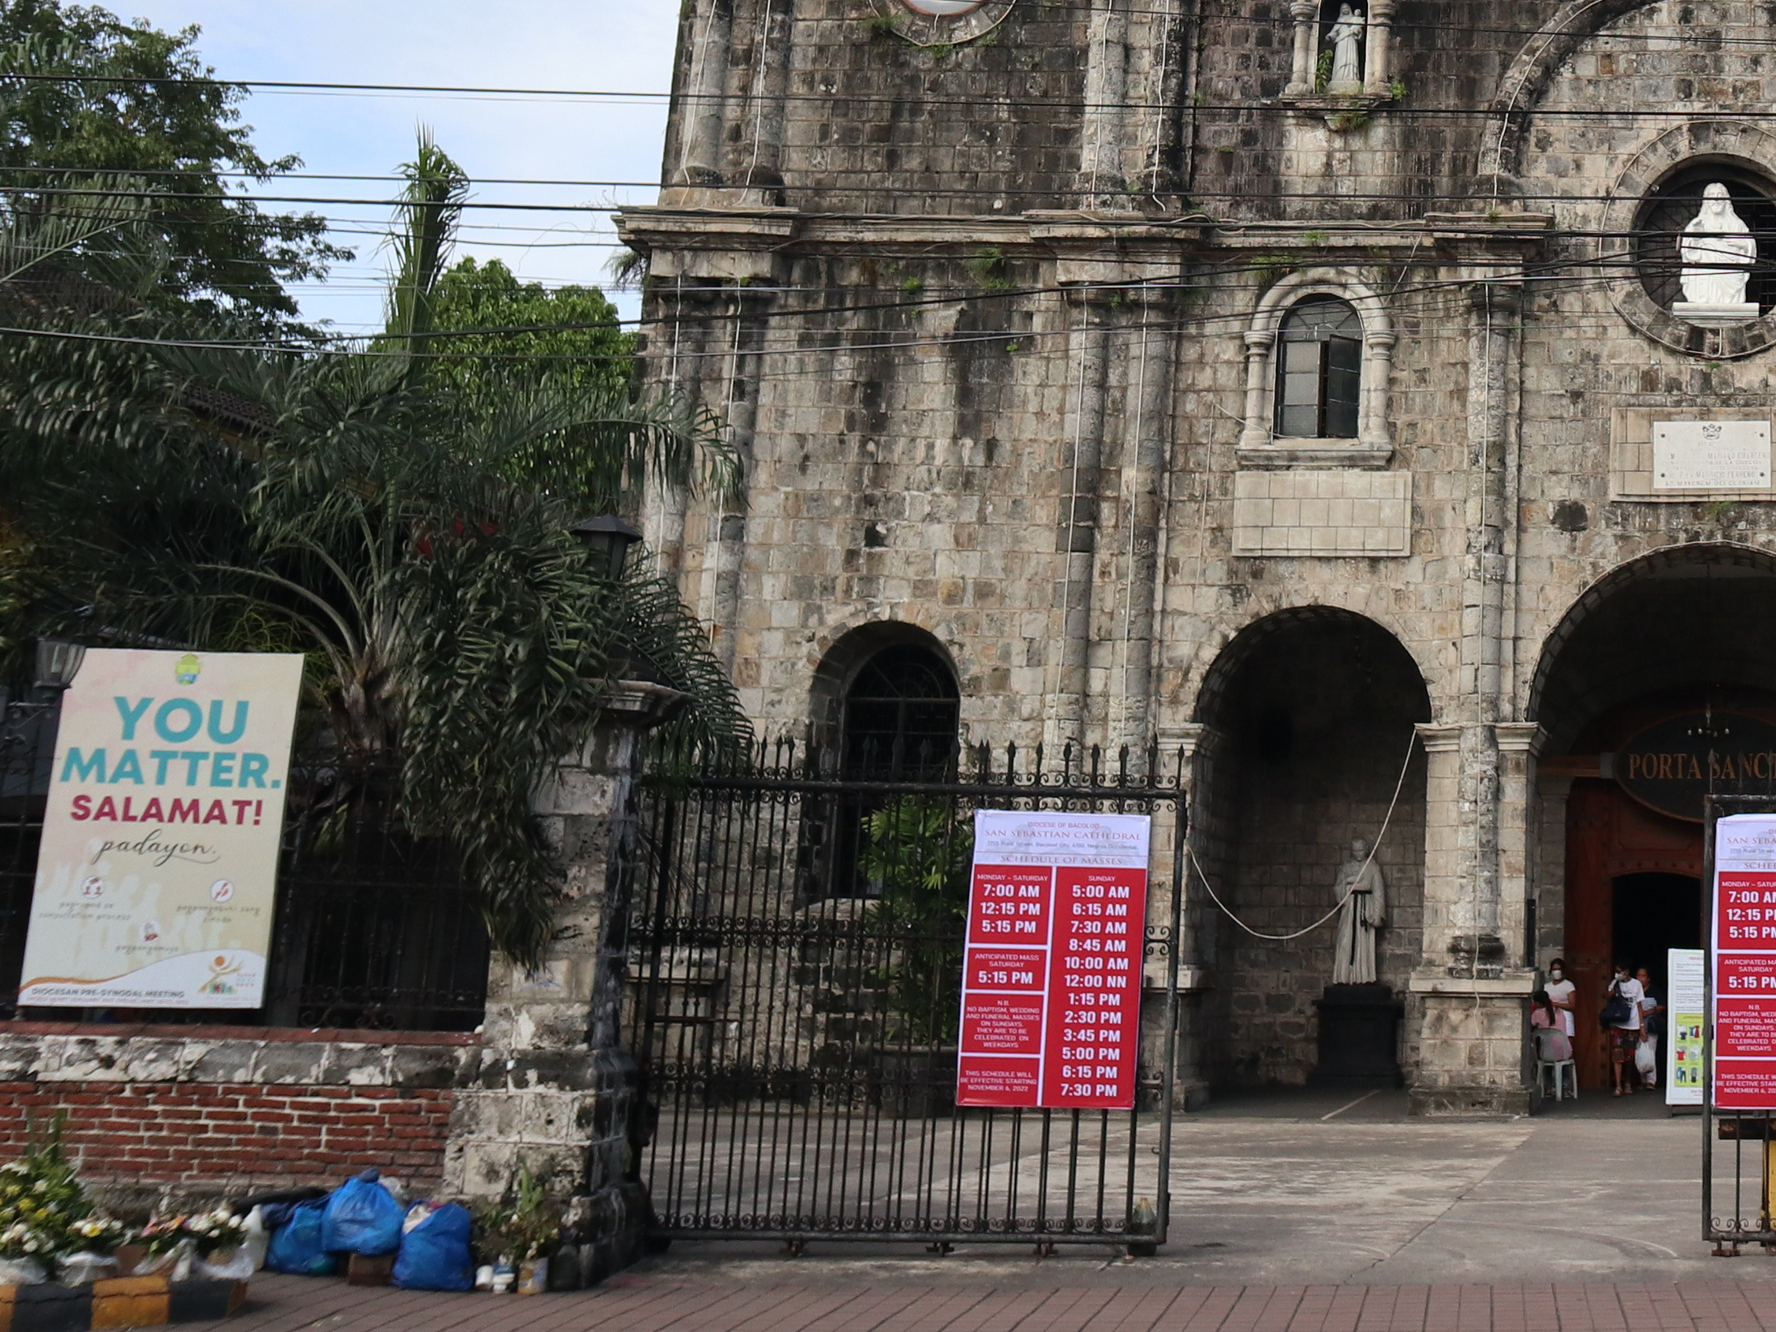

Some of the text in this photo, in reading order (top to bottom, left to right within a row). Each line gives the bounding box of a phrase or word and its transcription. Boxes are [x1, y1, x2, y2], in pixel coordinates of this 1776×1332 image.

[114, 696, 249, 745] YOU
[60, 747, 281, 789] MATTER.
[1629, 753, 1702, 779] PORTA
[70, 795, 263, 826] SALAMAT!
[985, 829, 1141, 841] SAN SEBASTIAN CATHEDRAL
[91, 829, 221, 866] padayon.
[1000, 855, 1122, 865] SCHEDULE OF MASSES
[983, 884, 1039, 897] 7:00 AM
[1072, 885, 1130, 898] 5:00 AM
[1729, 891, 1759, 903] 7:00
[980, 902, 1040, 915] 12:15 PM
[1073, 903, 1127, 916] 6:15 AM
[1726, 909, 1761, 921] 12:15
[982, 920, 1036, 933] 5:15 PM
[1071, 921, 1127, 934] 7:30 AM
[1729, 926, 1758, 938] 5:15
[1069, 939, 1126, 952] 8:45 AM
[1064, 957, 1128, 970] 10:00 AM
[978, 971, 1033, 984] 5:15 PM
[1065, 974, 1126, 988] 12:00 NN
[1729, 976, 1757, 988] 5:15
[31, 988, 78, 996] DIOCESAN
[1068, 993, 1120, 1006] 1:15 PM
[1065, 1011, 1121, 1024] 2:30 PM
[1064, 1029, 1121, 1042] 3:45 PM
[1062, 1047, 1120, 1060] 5:00 PM
[1062, 1065, 1117, 1078] 6:15 PM
[1061, 1083, 1117, 1097] 7:30 PM
